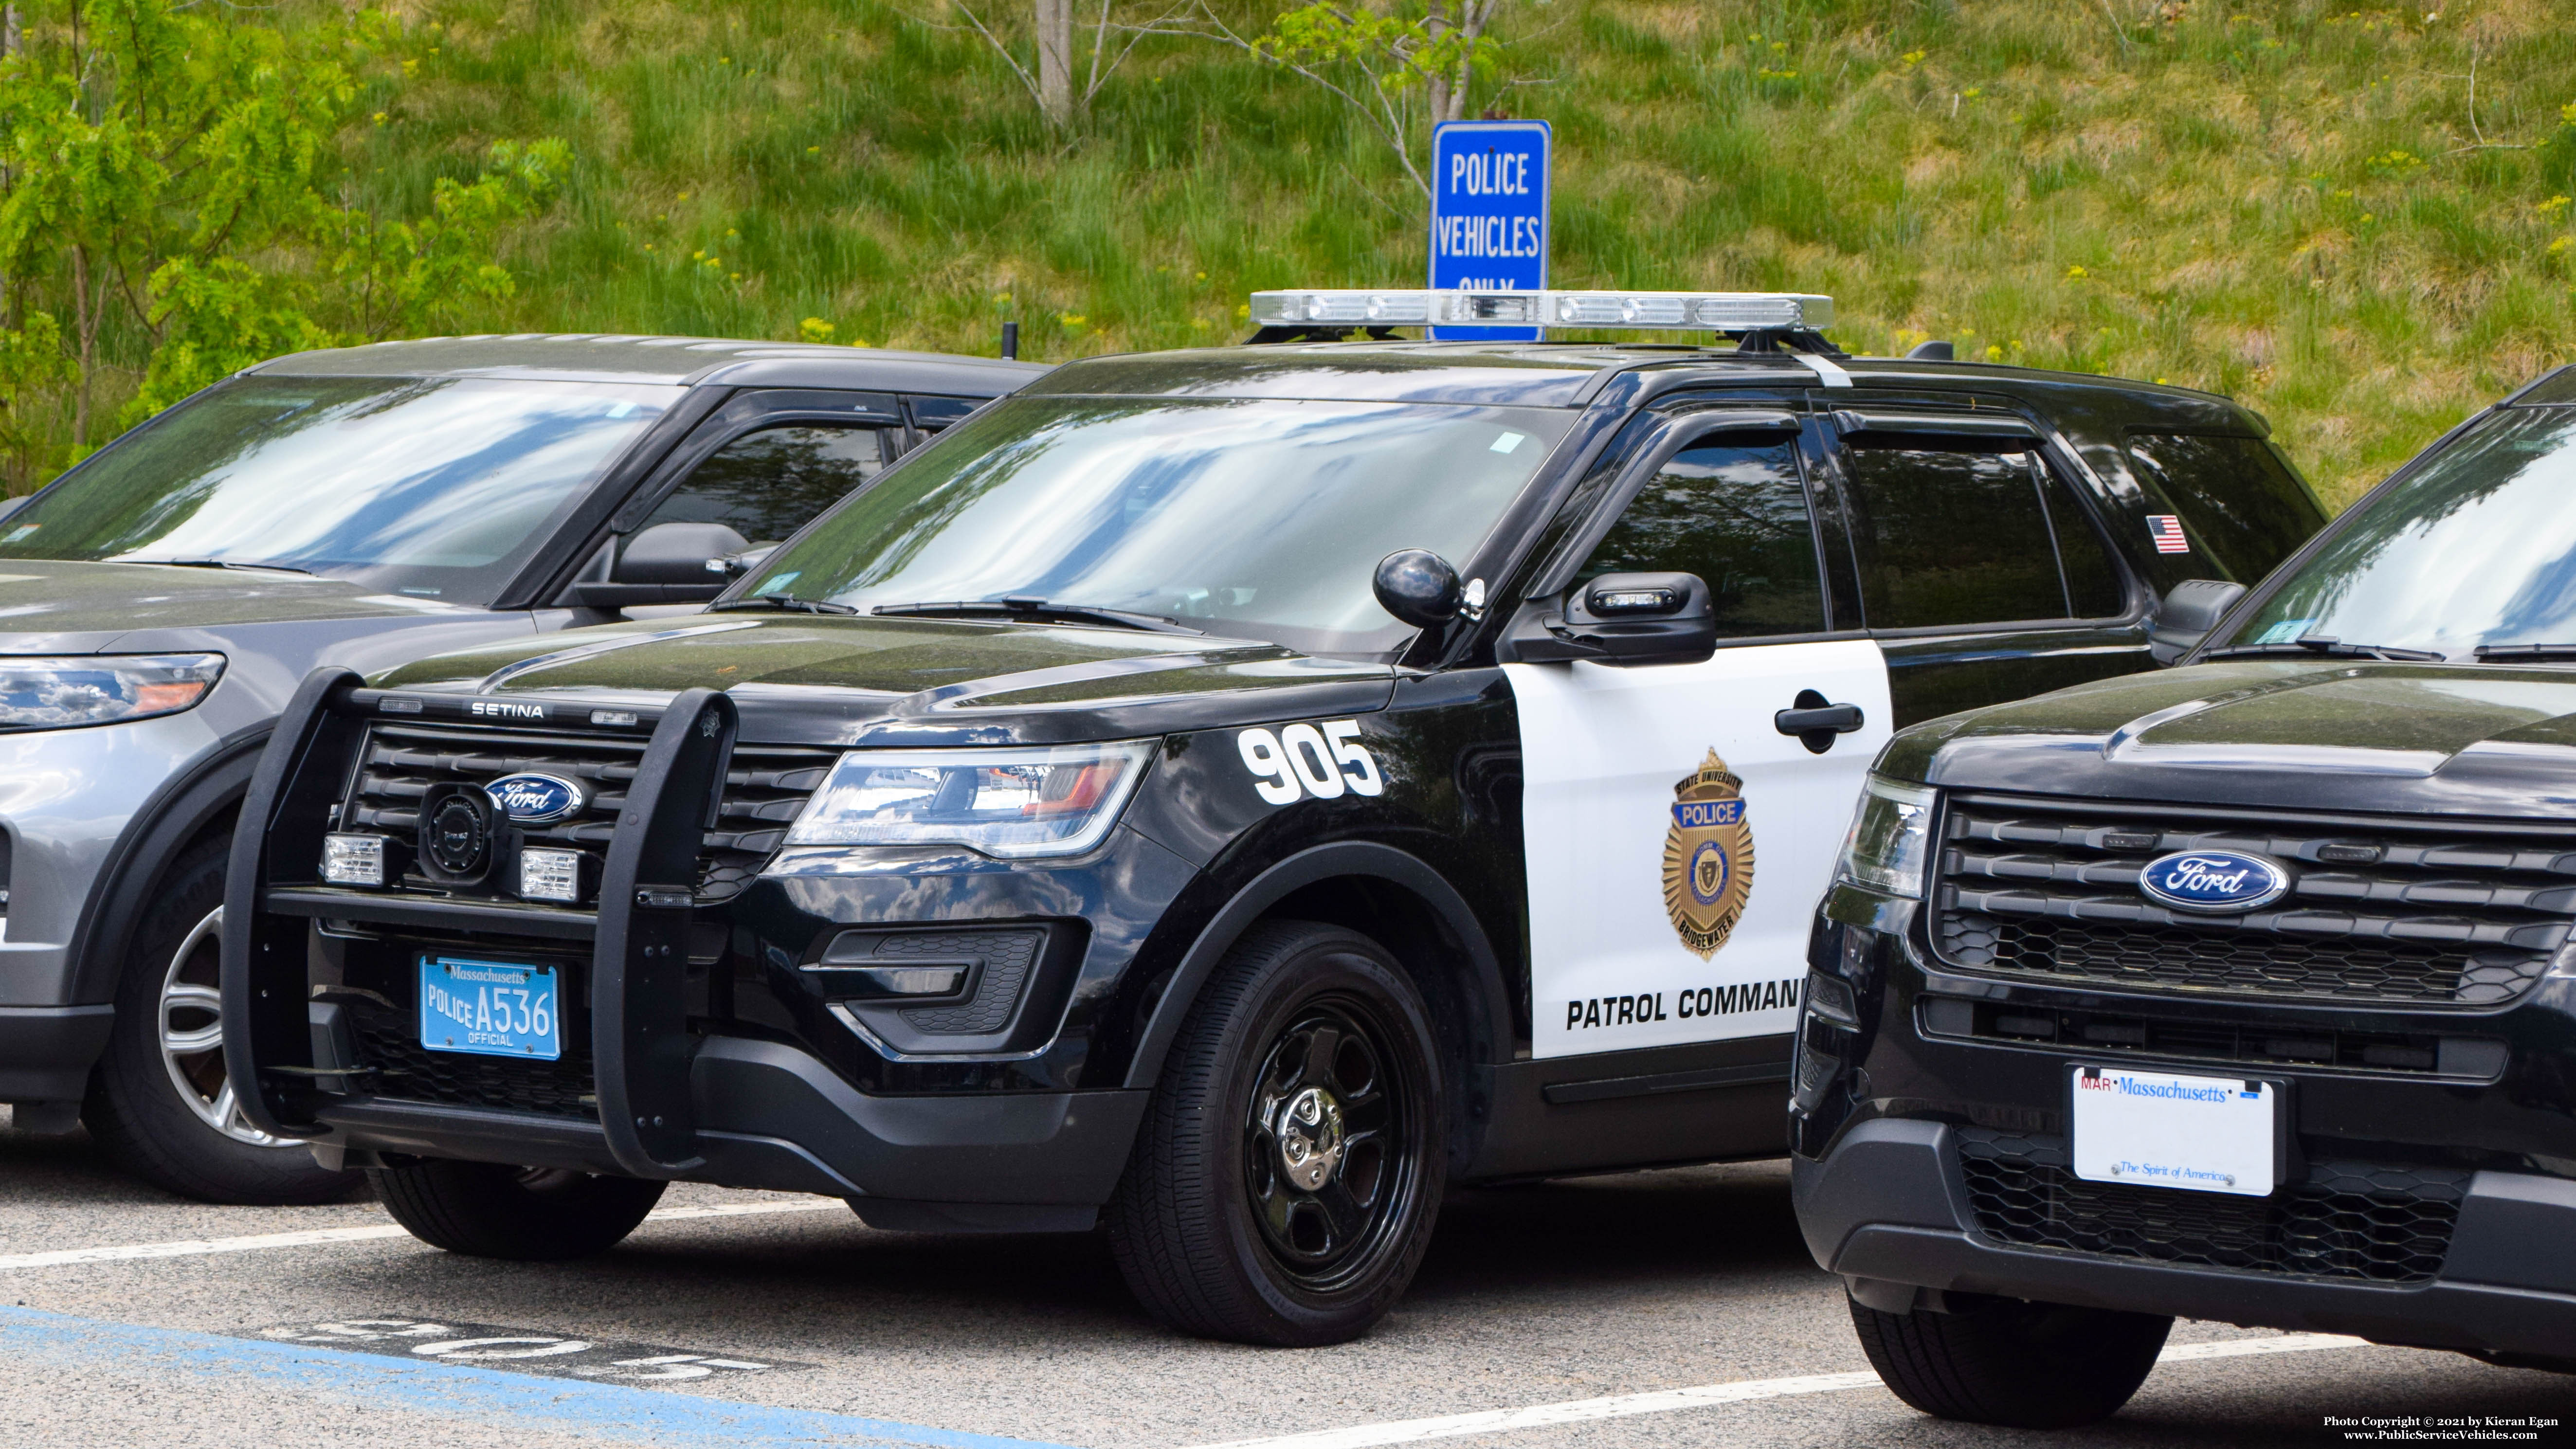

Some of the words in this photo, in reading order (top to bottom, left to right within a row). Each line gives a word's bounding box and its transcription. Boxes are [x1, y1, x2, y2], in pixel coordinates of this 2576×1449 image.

[1452, 153, 1528, 195] POLICE
[1438, 216, 1539, 257] VEHICLES
[472, 703, 544, 718] SETINA
[1238, 720, 1382, 805] 905
[497, 779, 554, 809] Ford
[1677, 774, 1699, 794] STATE
[1702, 771, 1742, 789] UNIVERSITY
[1683, 803, 1736, 825] POLICE
[2165, 857, 2249, 893] Ford
[1679, 915, 1734, 947] BRIDGEWATER
[450, 965, 526, 985] Massachusetts
[428, 984, 473, 1029] POLICE
[476, 986, 549, 1036] A536
[1566, 993, 1667, 1031] PATROL
[468, 1032, 513, 1047] OFFICIAL
[2081, 1076, 2111, 1091] MAR
[2119, 1077, 2226, 1103] Massachusetts
[2121, 1161, 2140, 1173] The
[2142, 1163, 2168, 1177] Spirit
[2172, 1167, 2181, 1179] of
[2183, 1167, 2226, 1181] America
[259, 1320, 771, 1379] 905
